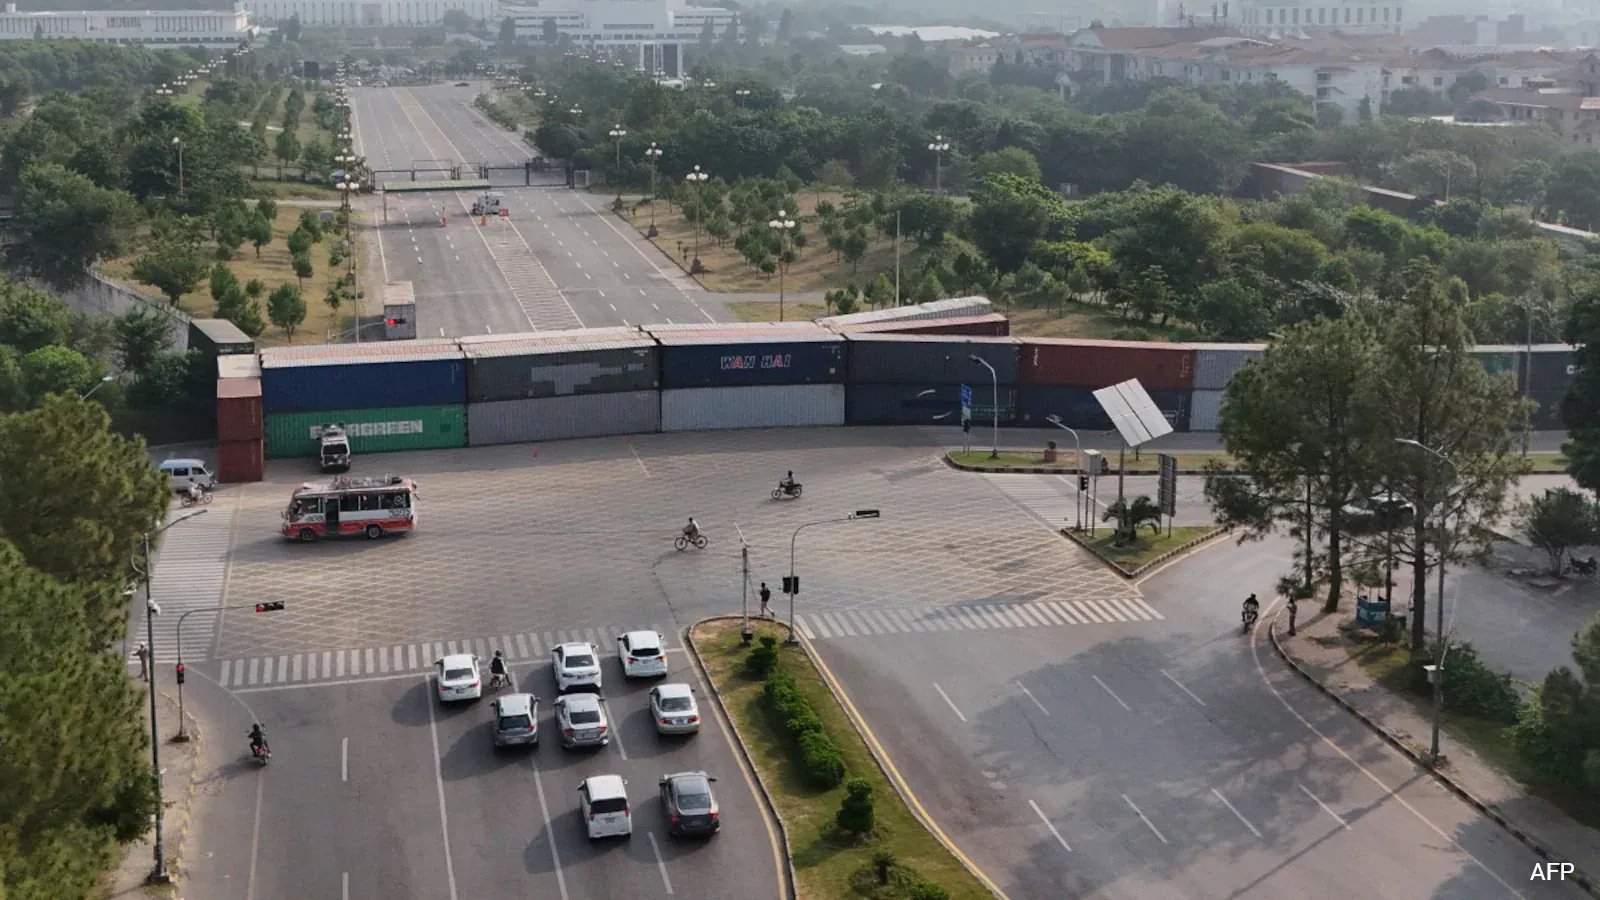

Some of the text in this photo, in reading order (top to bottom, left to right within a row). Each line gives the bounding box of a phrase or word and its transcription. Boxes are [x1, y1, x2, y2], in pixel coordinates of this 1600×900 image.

[720, 354, 792, 370] WAN HAI
[309, 419, 423, 440] ERGREEN
